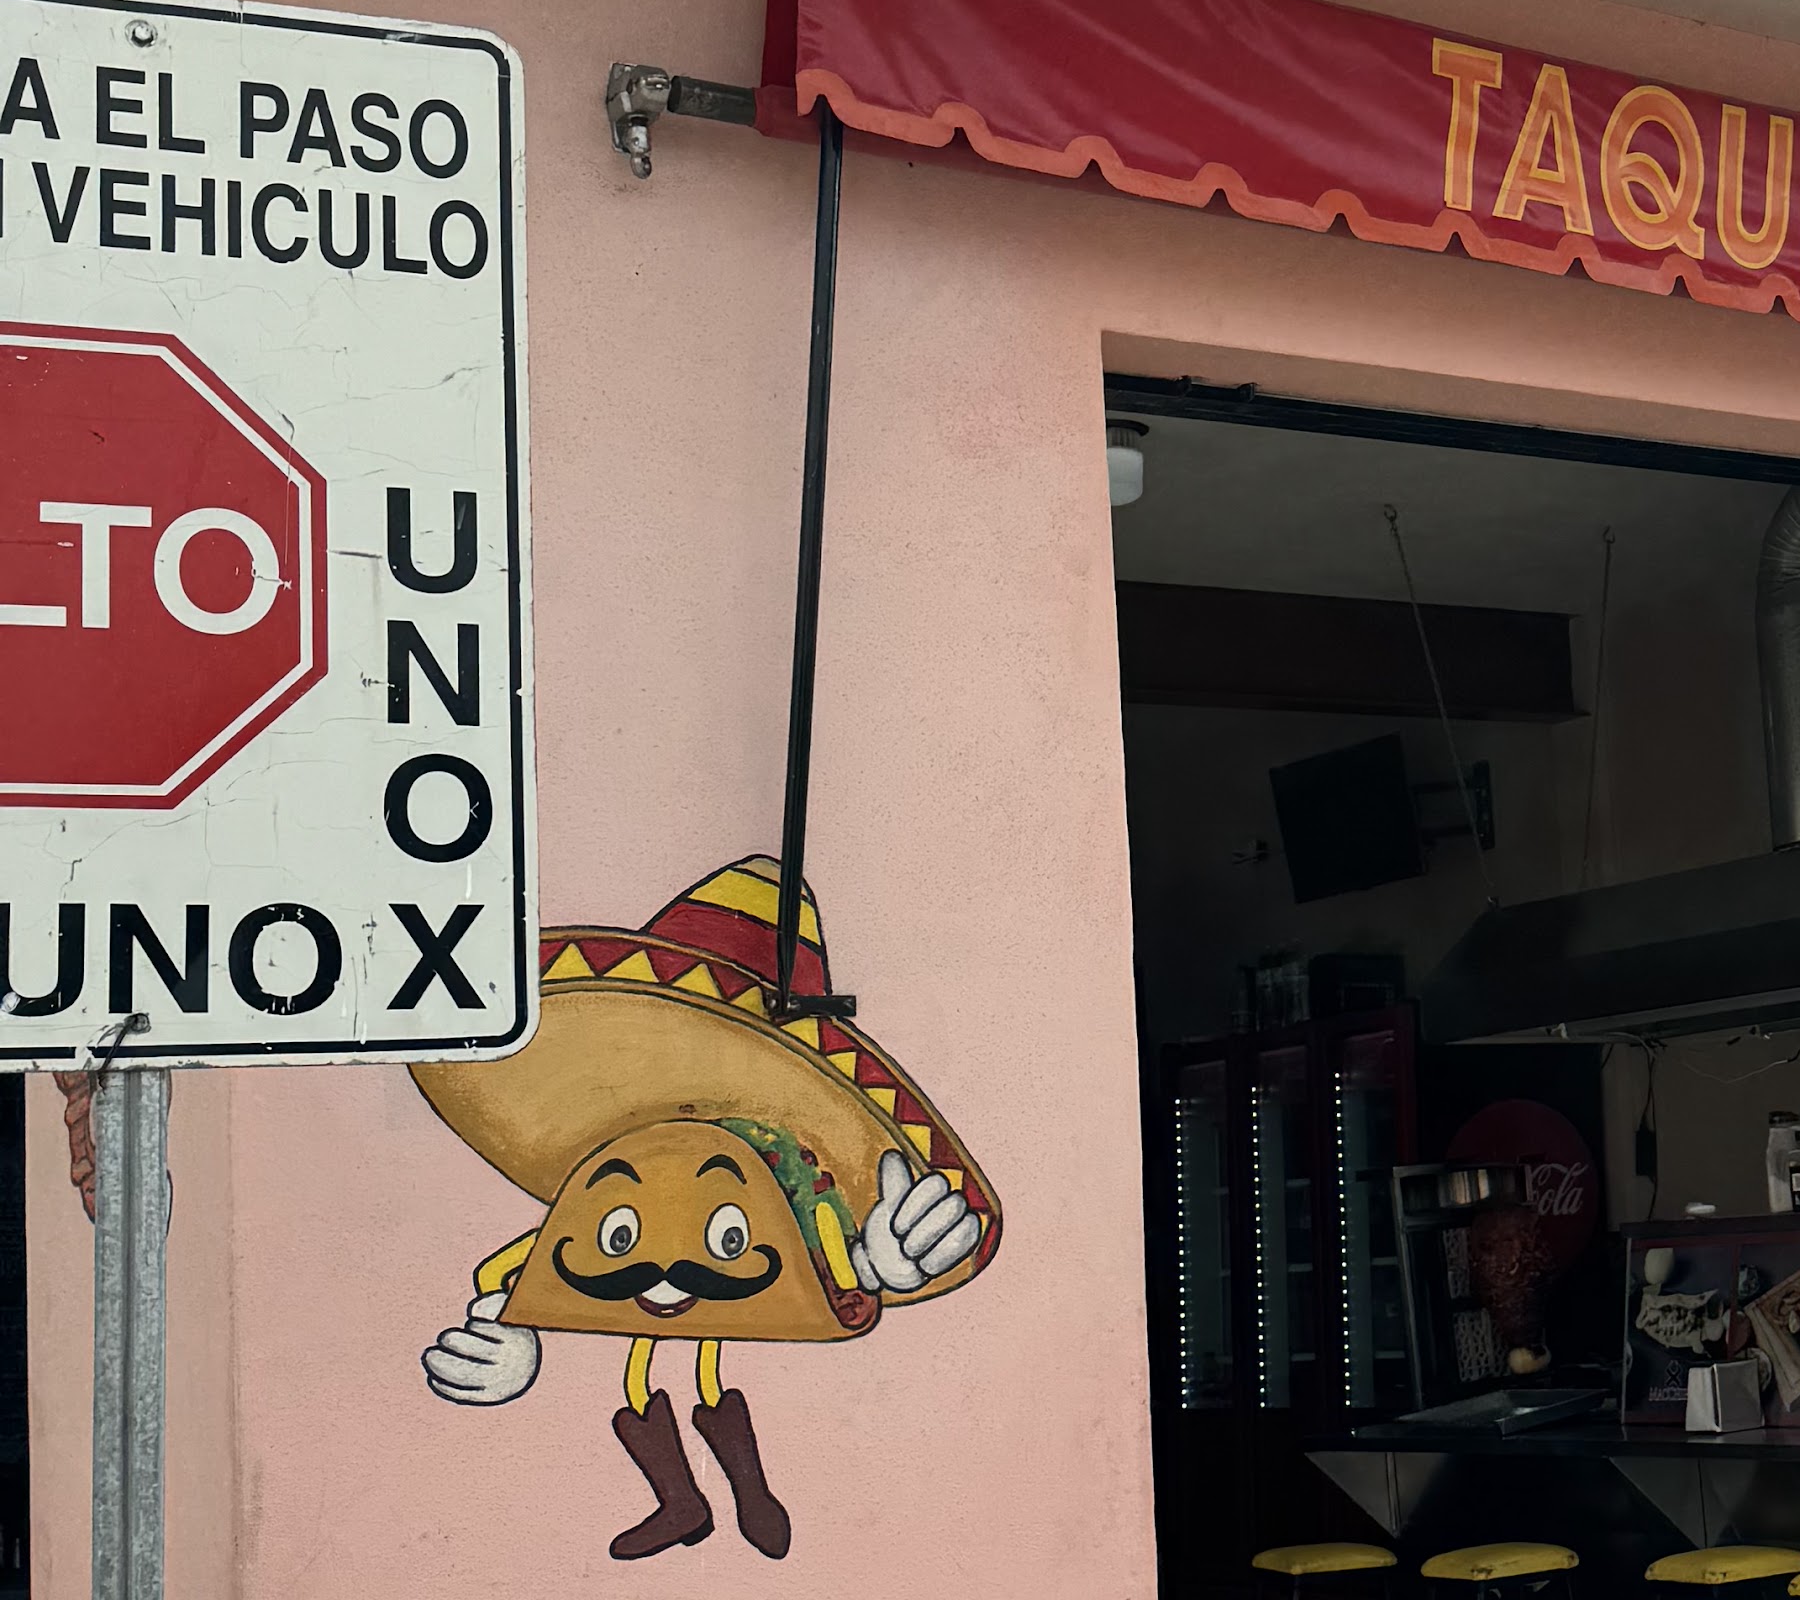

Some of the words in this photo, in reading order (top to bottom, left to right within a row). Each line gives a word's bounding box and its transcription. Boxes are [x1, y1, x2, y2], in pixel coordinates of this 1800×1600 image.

[0, 57, 60, 140] A
[96, 65, 206, 154] EL
[240, 80, 469, 179] PASO
[31, 161, 489, 280] VEHICULO
[386, 903, 487, 1010] X
